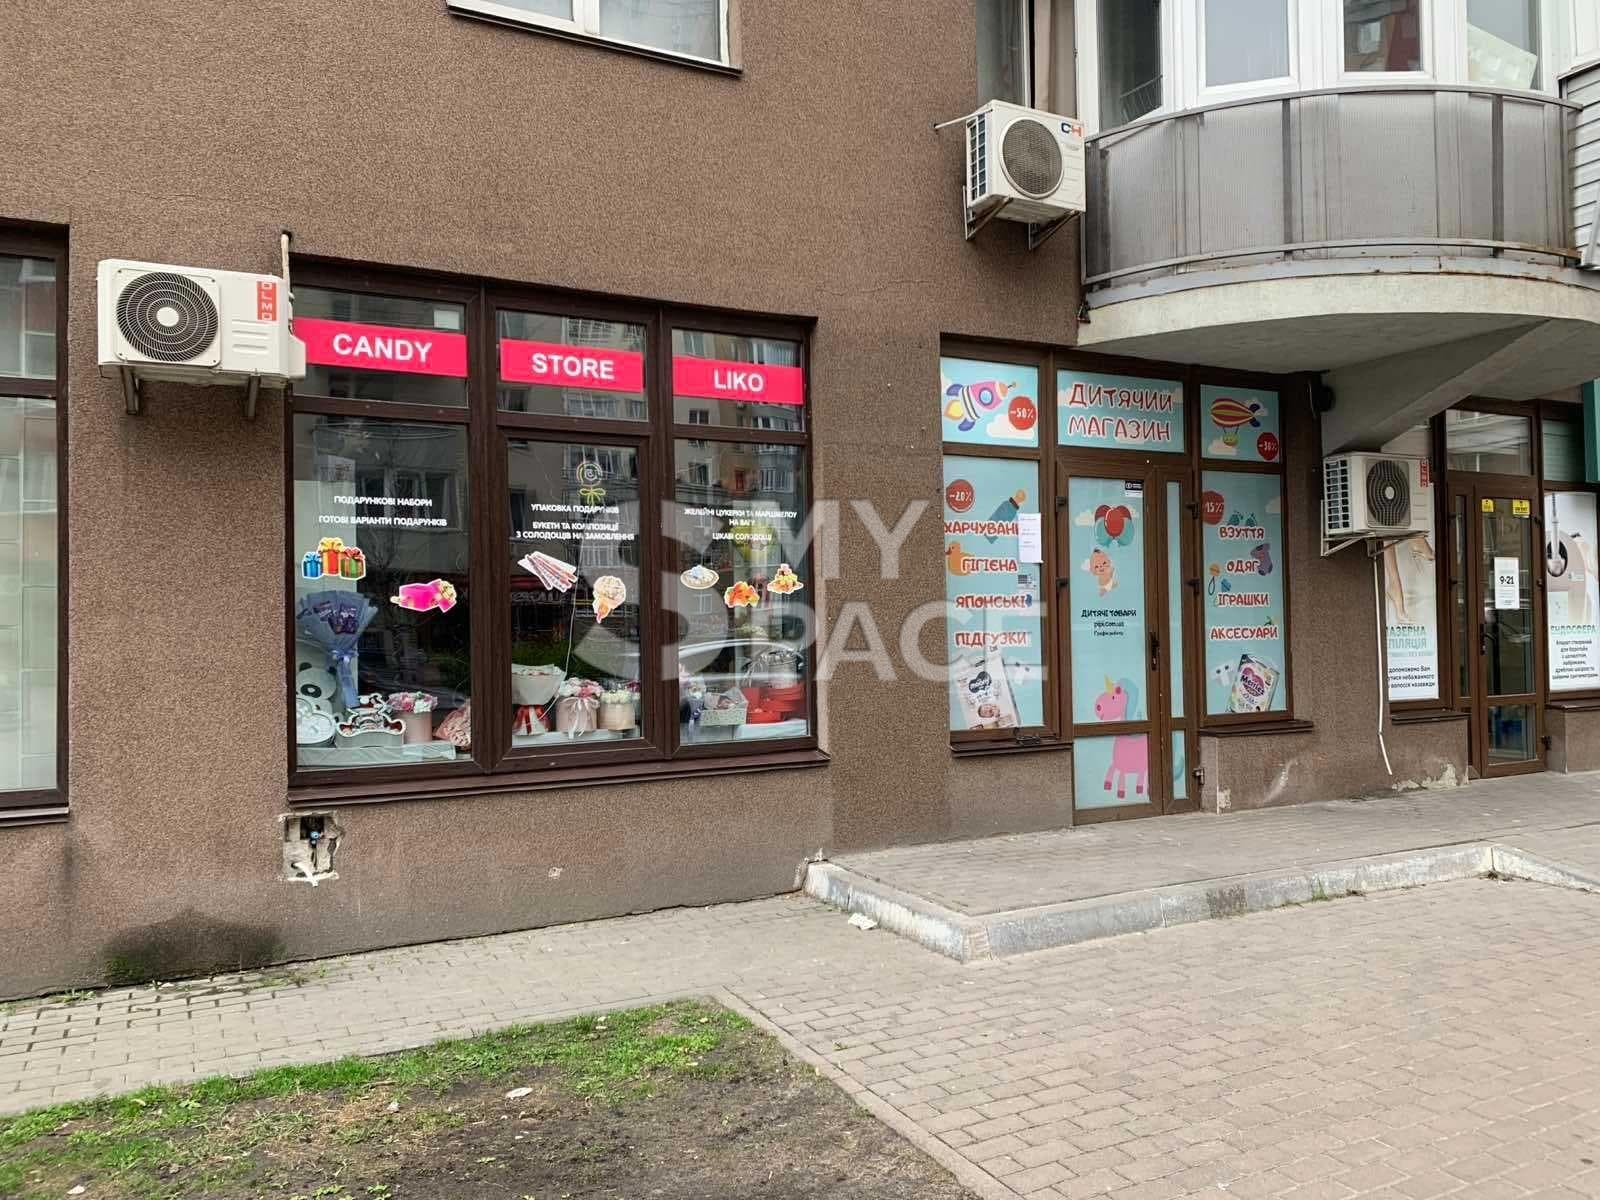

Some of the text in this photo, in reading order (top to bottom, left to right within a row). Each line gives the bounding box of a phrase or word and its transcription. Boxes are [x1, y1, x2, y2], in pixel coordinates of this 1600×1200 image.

[332, 333, 764, 392] CANDY STORE LIKO
[1010, 407, 1034, 419] -50%
[1068, 416, 1170, 441] МАГАЗИН
[333, 495, 433, 507] ПОДАРУНКОВІ НАБОРИ
[530, 503, 571, 513] УПАКОВКА
[318, 515, 448, 527] ГОТОВІ ВАРІАНТИ ПОДАРУНКІВ
[532, 521, 560, 530] БУКЕТИ
[561, 522, 570, 530] ТА
[522, 531, 572, 541] СОЛОДОЩІВ
[585, 532, 635, 541] ЗАМОВЛЕННЯ
[1219, 526, 1265, 539] ВЗУТТЯ
[962, 558, 1018, 572] ГІГІЄНА
[1226, 560, 1258, 573] ОДЯГ
[955, 595, 1026, 609] ЯПОНСЬКІ
[1218, 593, 1269, 606] ІГРАШКИ
[1210, 626, 1278, 640] АКСЕСУАРИ
[1386, 625, 1427, 637] АЗЕРНА
[955, 632, 1027, 648] ПІДГУЗКИ
